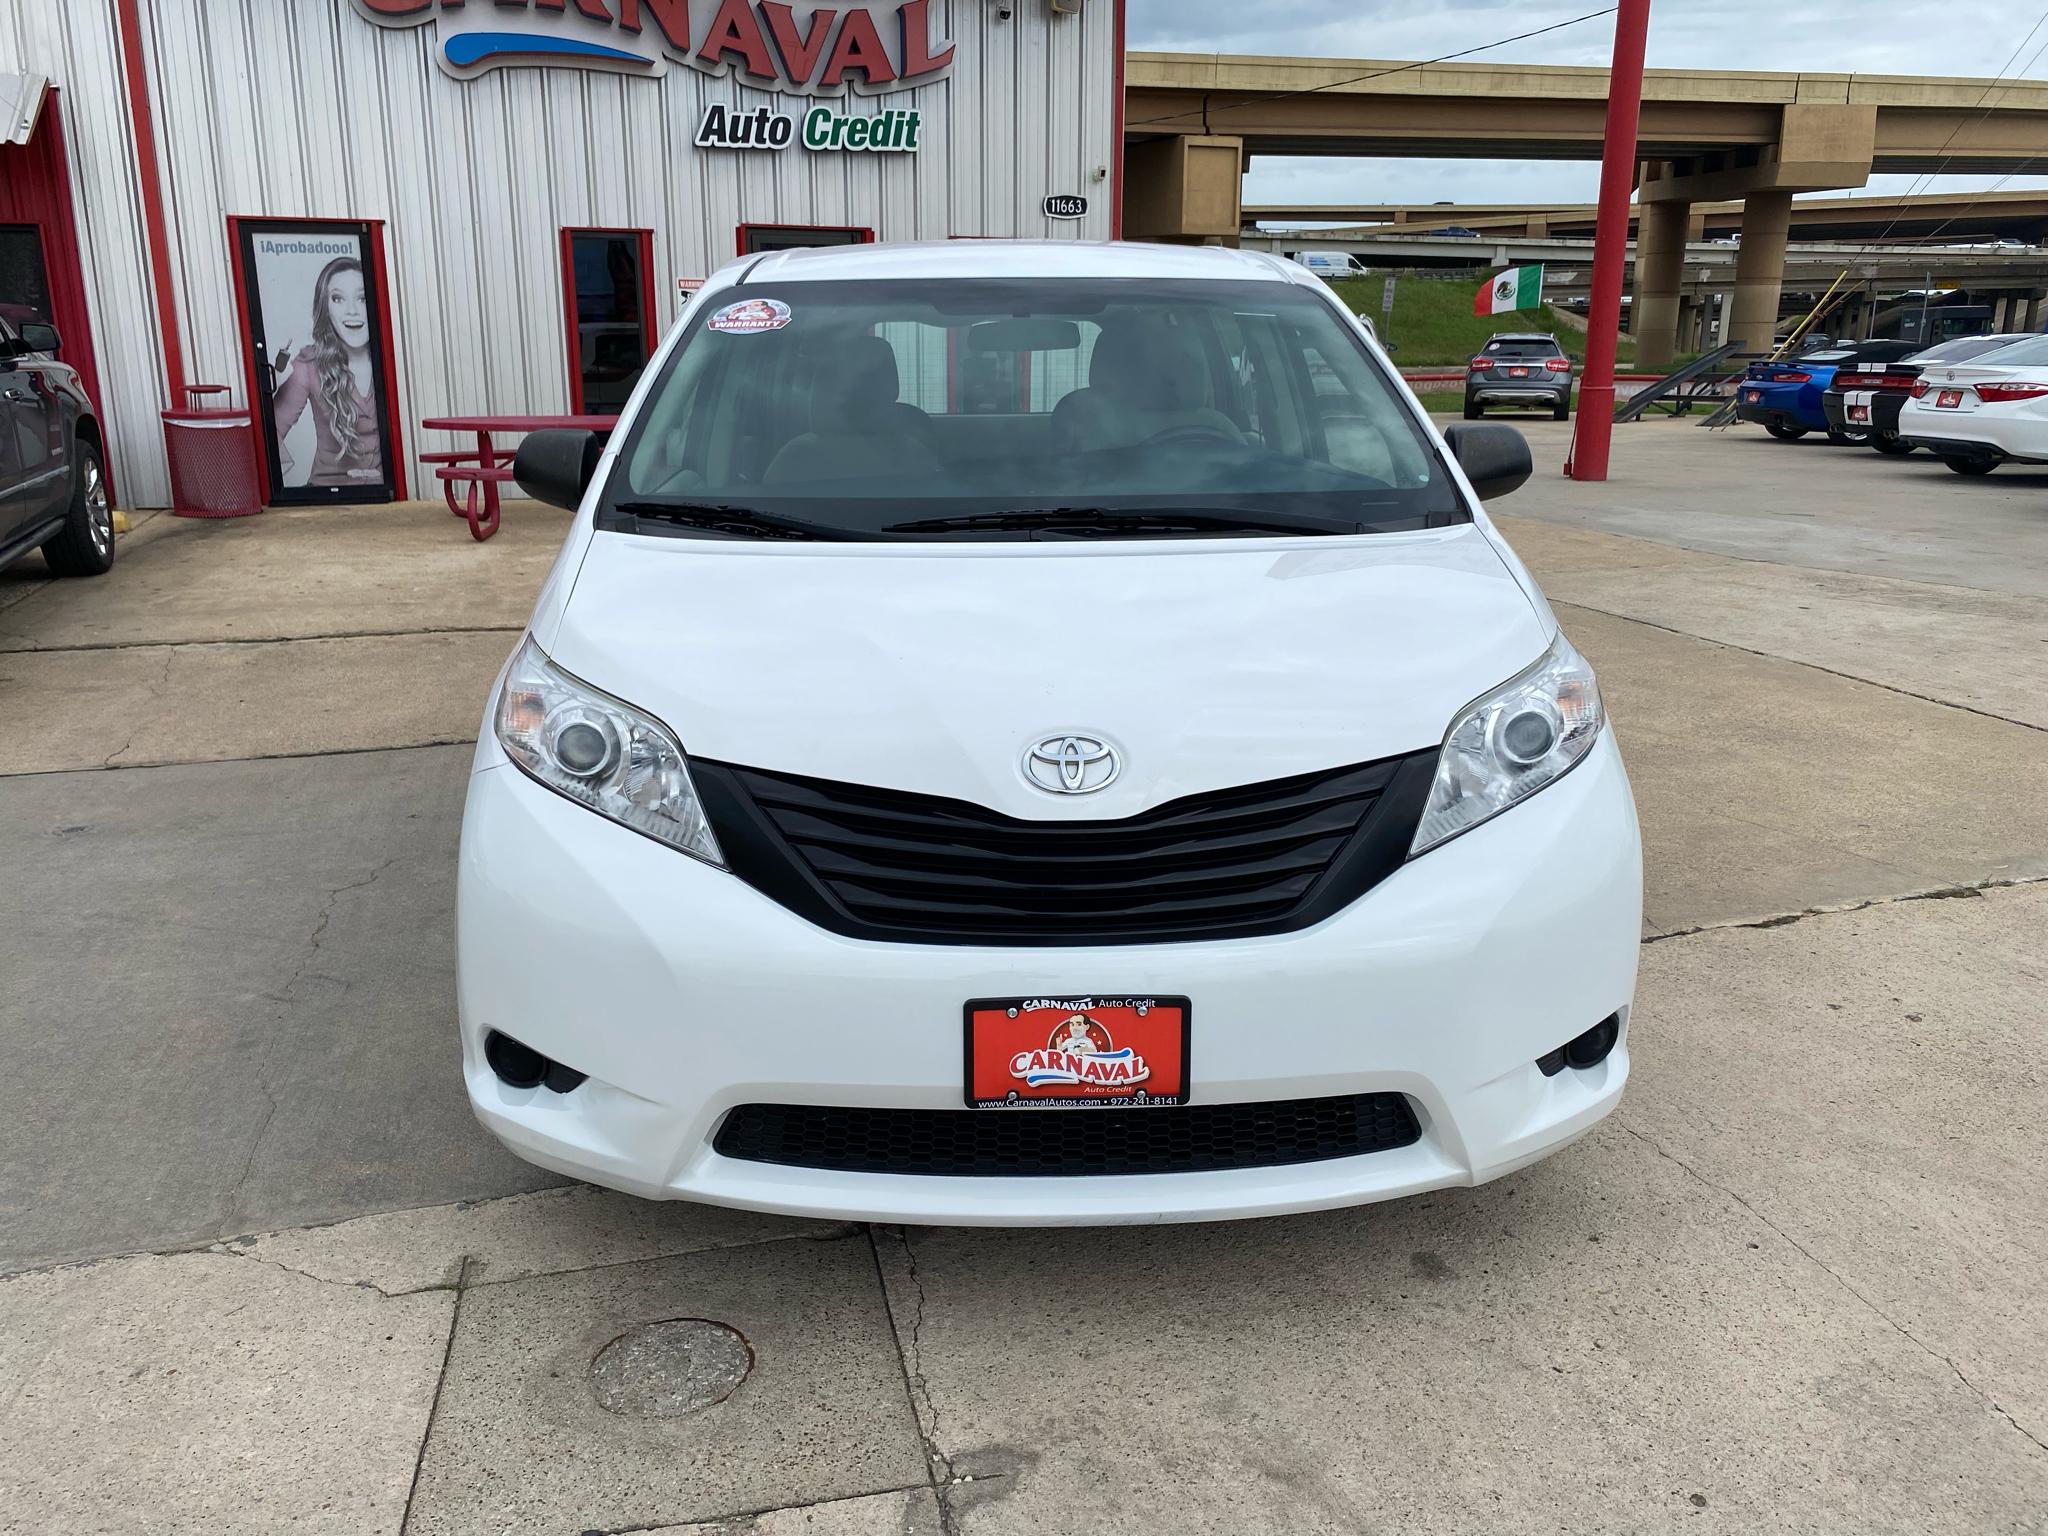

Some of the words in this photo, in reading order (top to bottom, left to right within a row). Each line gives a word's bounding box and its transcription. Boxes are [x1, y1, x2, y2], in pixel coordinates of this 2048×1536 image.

[358, 0, 955, 88] NAVAL
[698, 104, 792, 145] Auto
[804, 108, 921, 149] Credit
[1051, 199, 1082, 213] 11663
[714, 320, 781, 329] WARRANTY
[1022, 998, 1096, 1011] CARNAVAL
[1098, 999, 1123, 1008] Auto
[1125, 998, 1156, 1008] Credit
[1010, 1050, 1149, 1083] CARNAVAL
[978, 1097, 1101, 1109] www.CarnavalAutos.com
[1110, 1097, 1178, 1107] 972-241-8141
